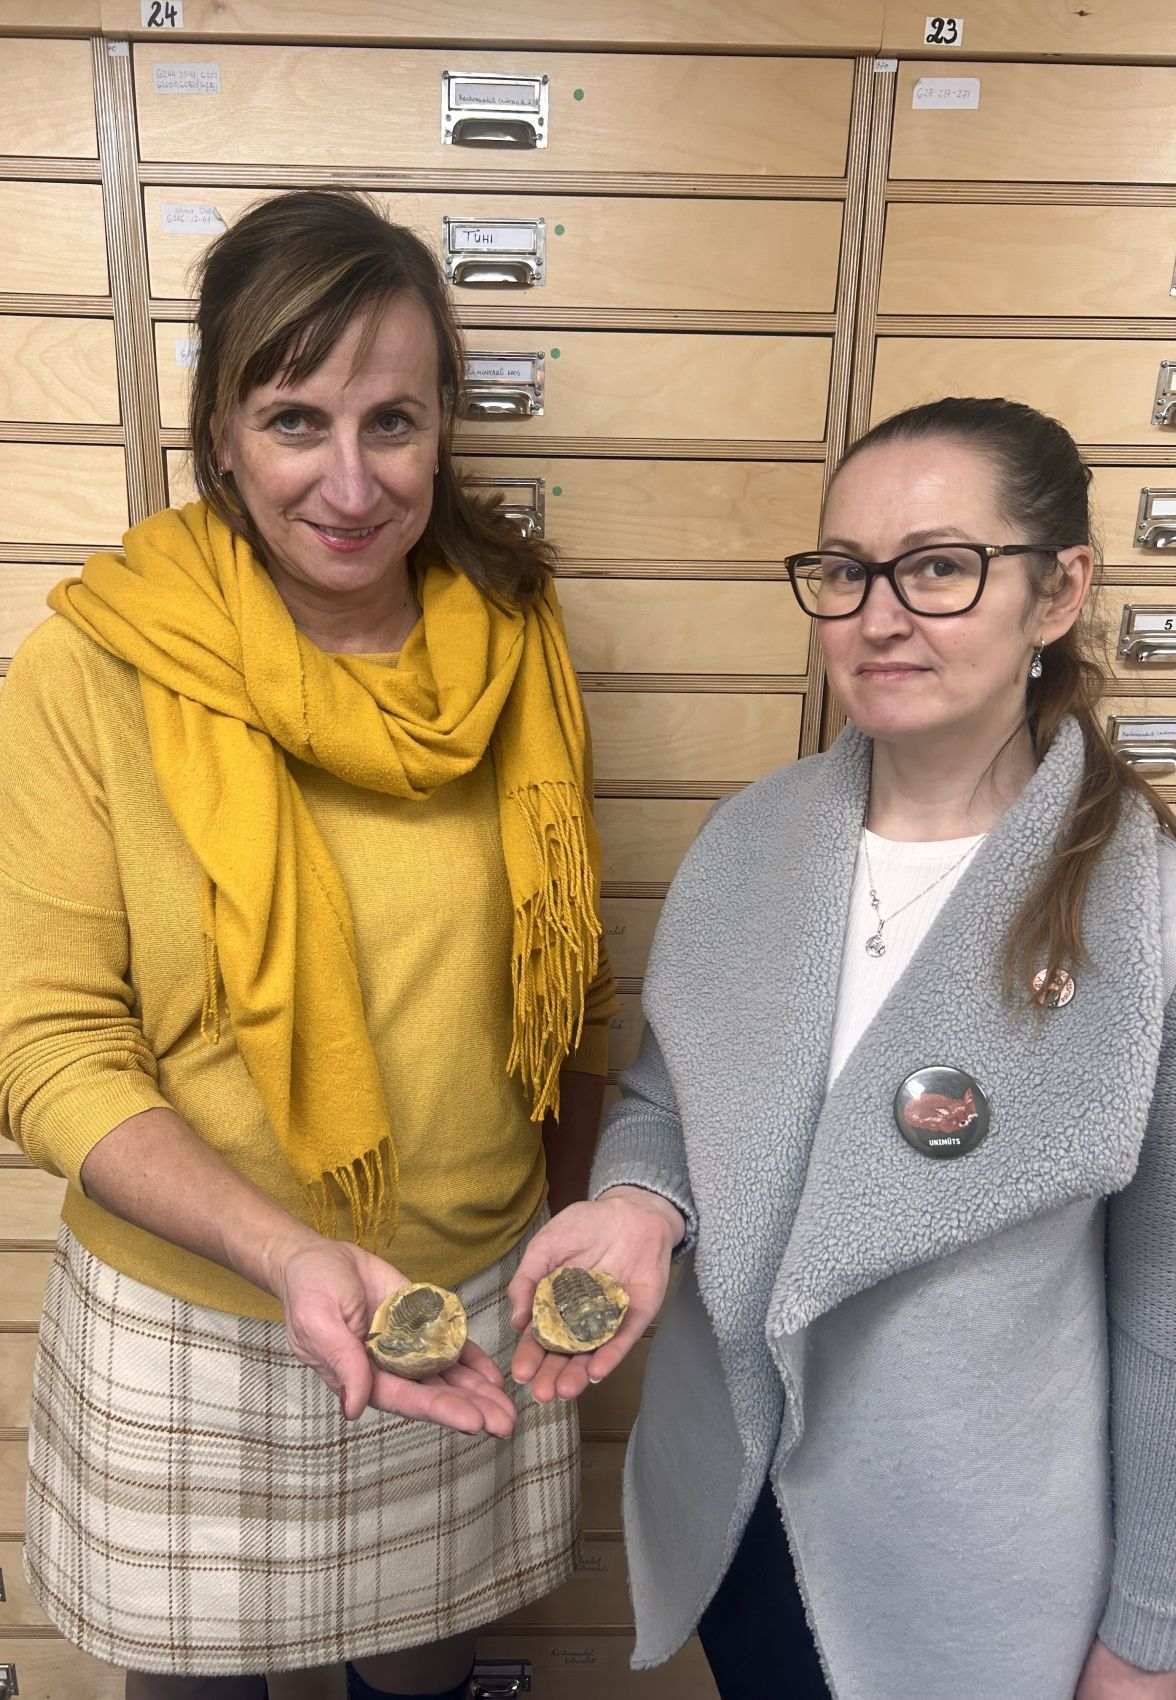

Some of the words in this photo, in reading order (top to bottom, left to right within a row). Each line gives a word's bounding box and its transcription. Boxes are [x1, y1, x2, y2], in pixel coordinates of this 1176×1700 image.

[147, 1, 178, 28] 24
[926, 17, 958, 44] 23
[463, 229, 493, 244] TÜHI
[1164, 619, 1174, 631] 5
